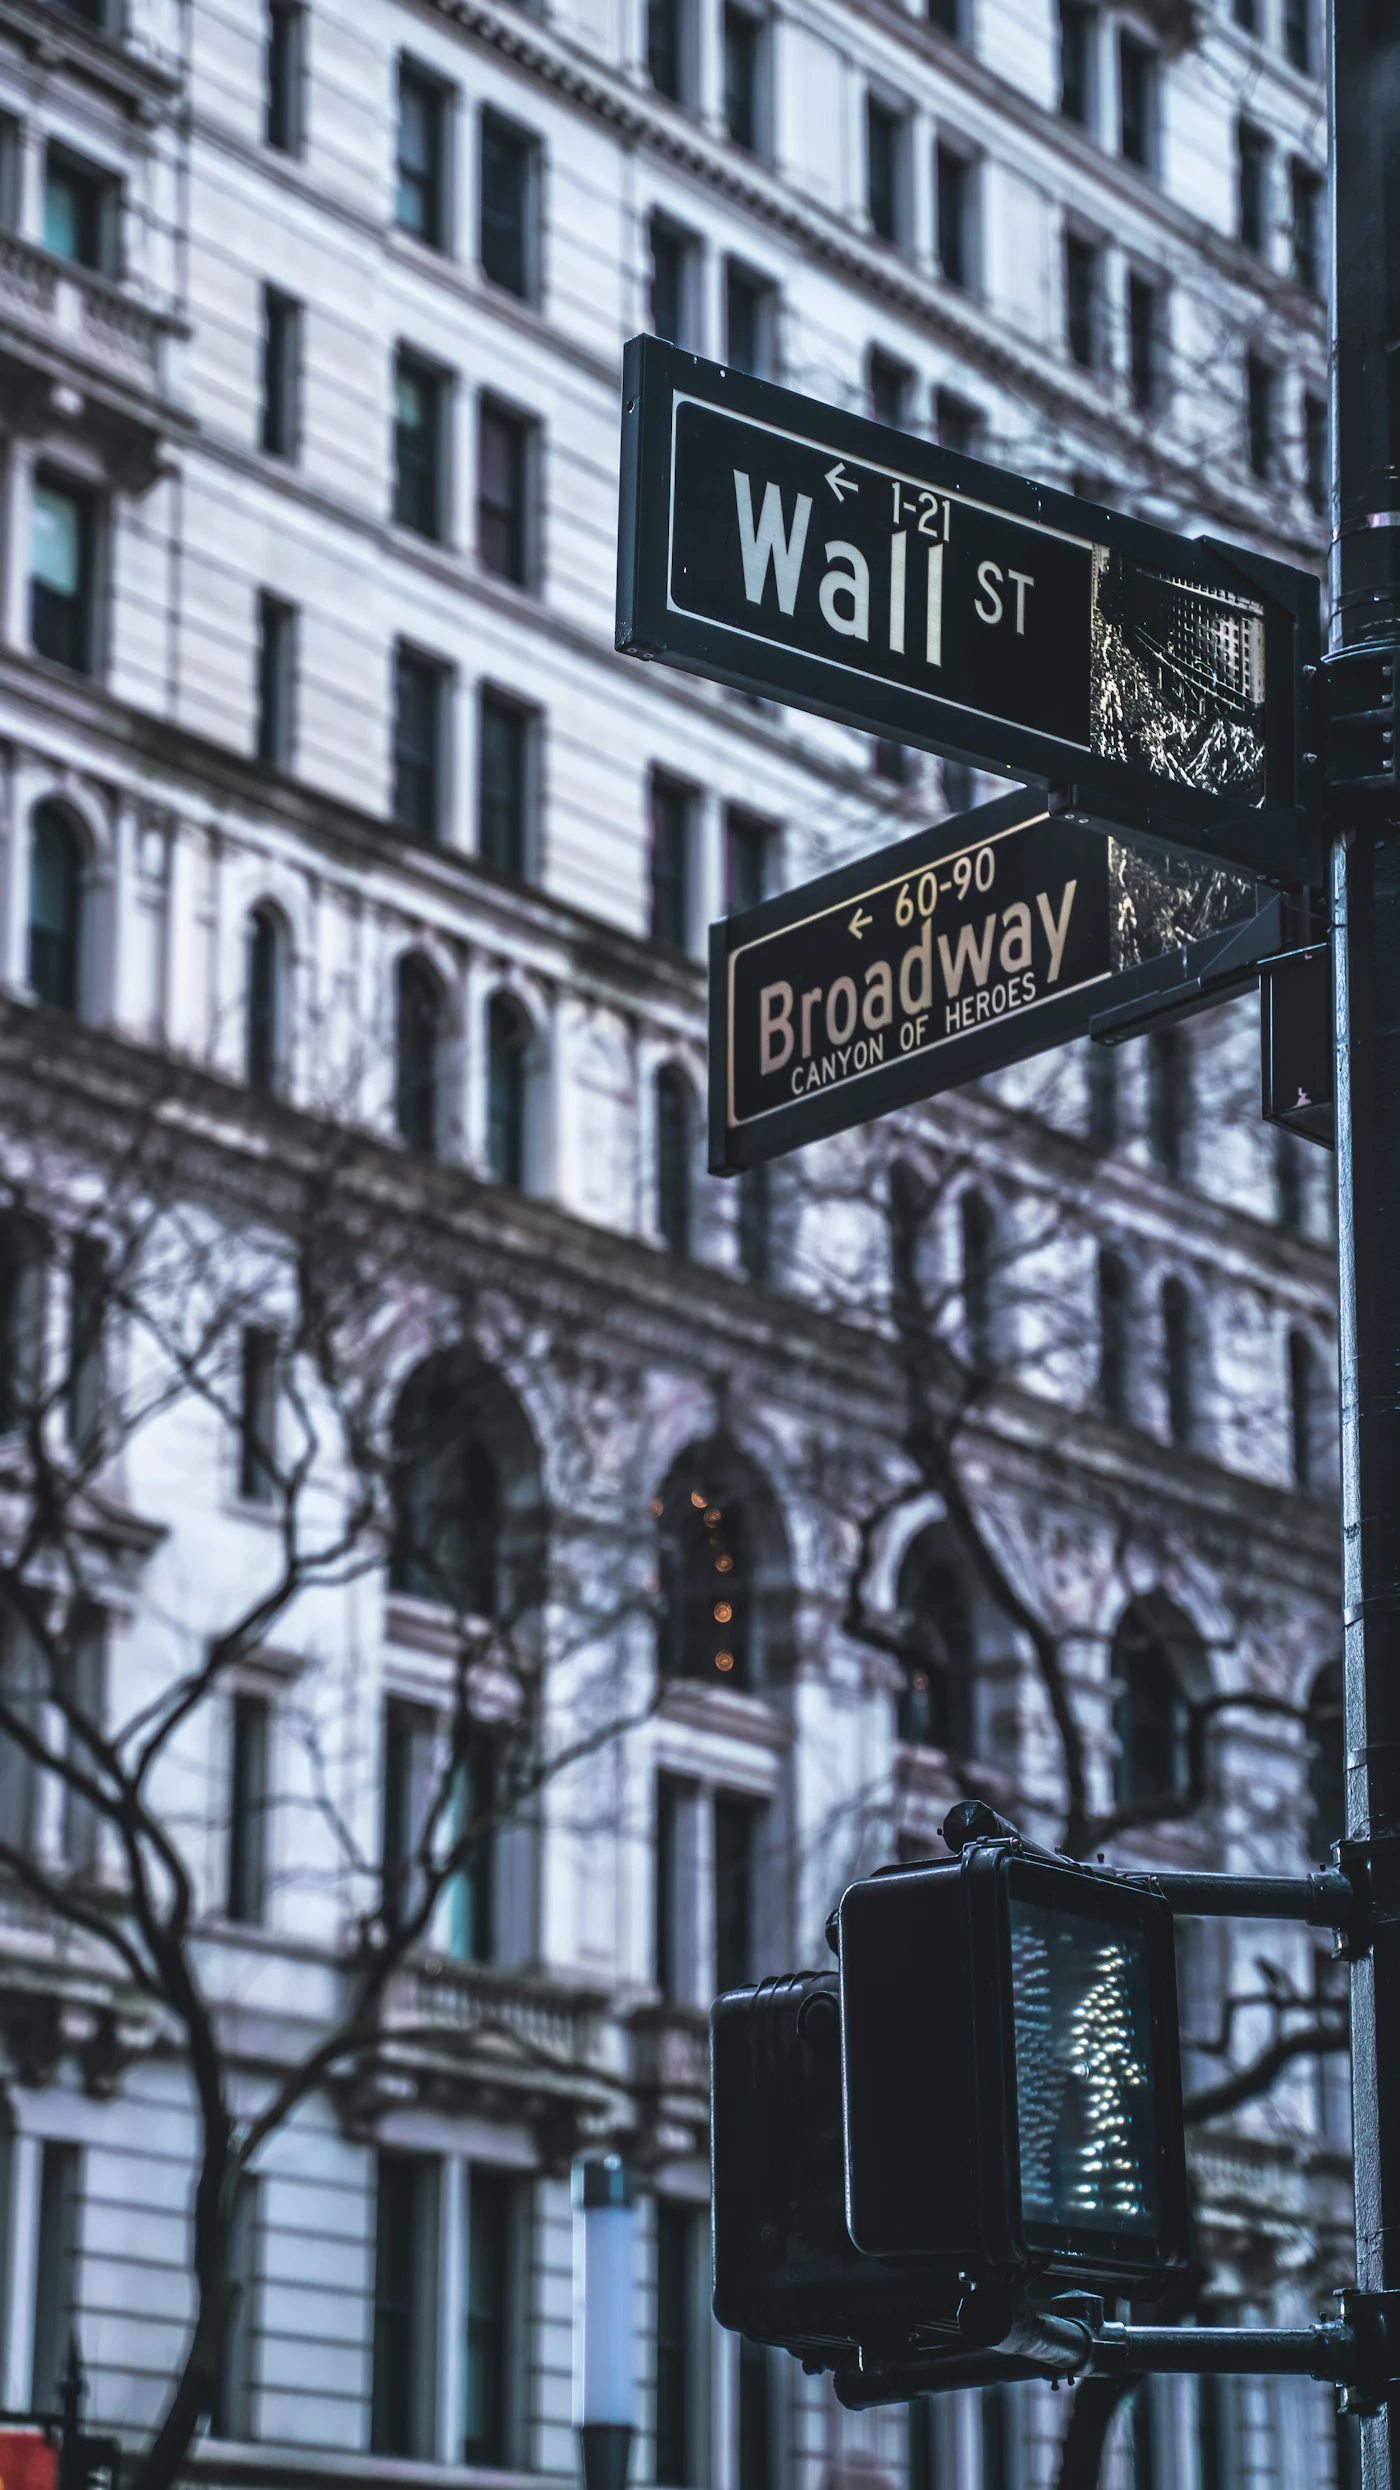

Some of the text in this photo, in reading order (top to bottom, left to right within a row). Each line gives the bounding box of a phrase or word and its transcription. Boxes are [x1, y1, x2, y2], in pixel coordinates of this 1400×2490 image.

[733, 469, 1034, 667] Wall ST
[892, 482, 950, 543] 1-21
[895, 847, 995, 927] 60-90
[760, 879, 1077, 1075] Broadway
[791, 972, 1036, 1095] CANYON OF HEROES
